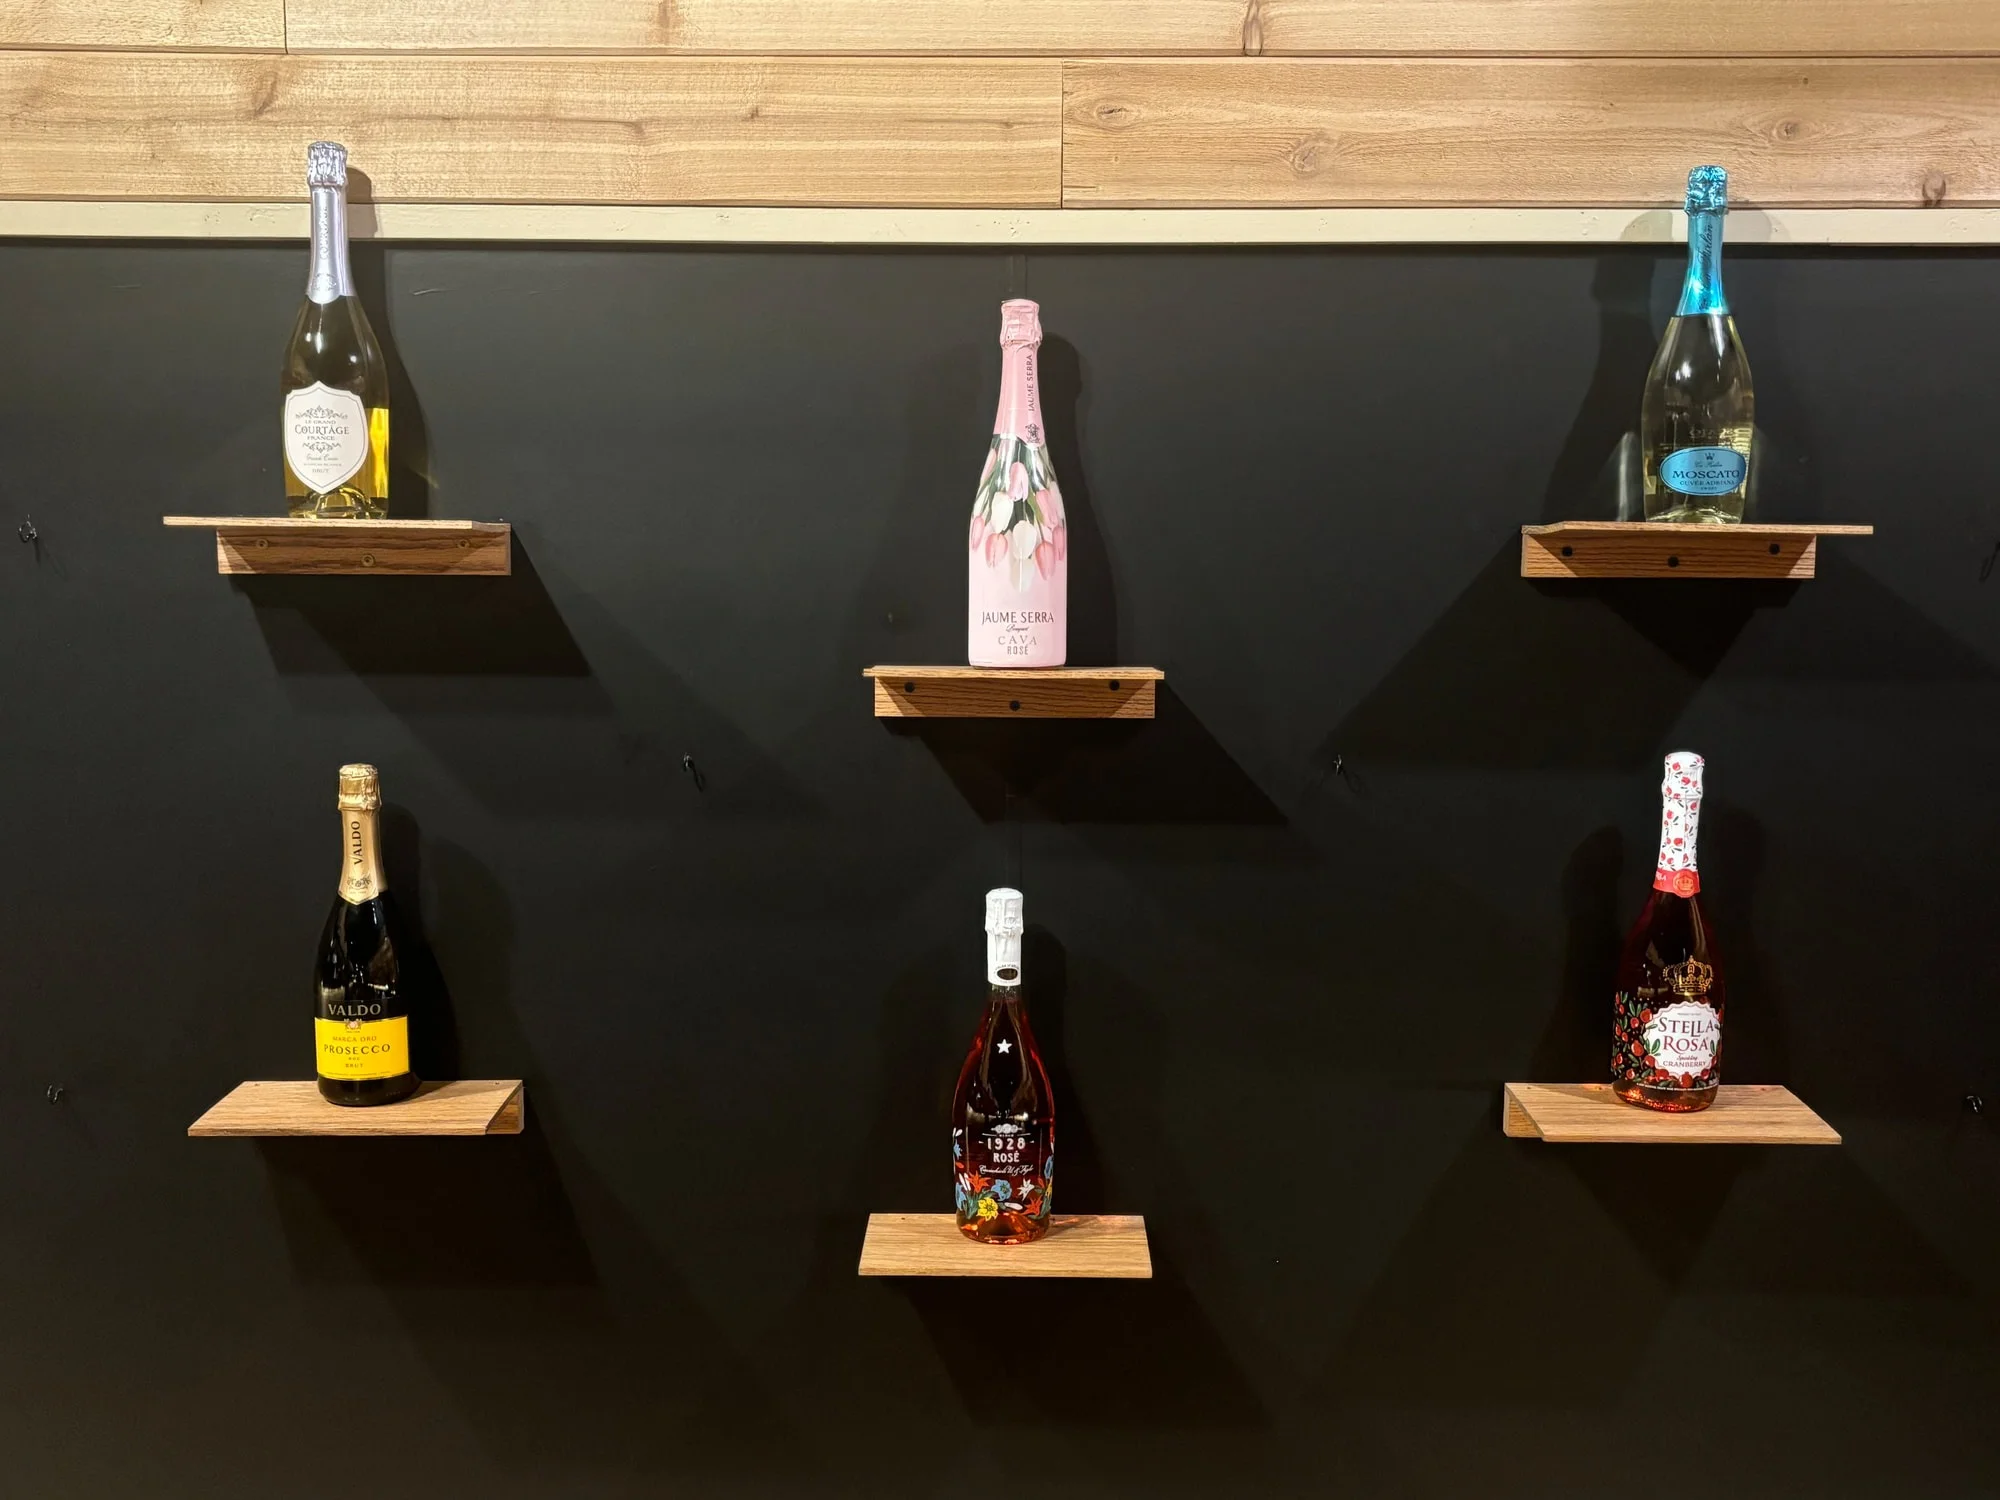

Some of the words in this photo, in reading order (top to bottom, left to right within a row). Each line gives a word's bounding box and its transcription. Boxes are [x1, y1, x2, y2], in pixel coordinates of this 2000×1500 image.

[1026, 354, 1034, 381] SERRA
[1672, 470, 1740, 479] MOSCATO
[982, 611, 1017, 625] JAUME
[1020, 611, 1054, 624] SERRA
[998, 635, 1037, 645] CAVA
[1007, 644, 1028, 655] ROSÉ
[351, 821, 363, 865] VALDO
[328, 1003, 381, 1016] VALDO
[1658, 1016, 1714, 1037] STELLA
[324, 1043, 390, 1055] PROSECCO
[1662, 1060, 1706, 1068] CRANBERRY
[987, 1137, 1026, 1150] 1928
[993, 1150, 1020, 1163] ROSÉ
